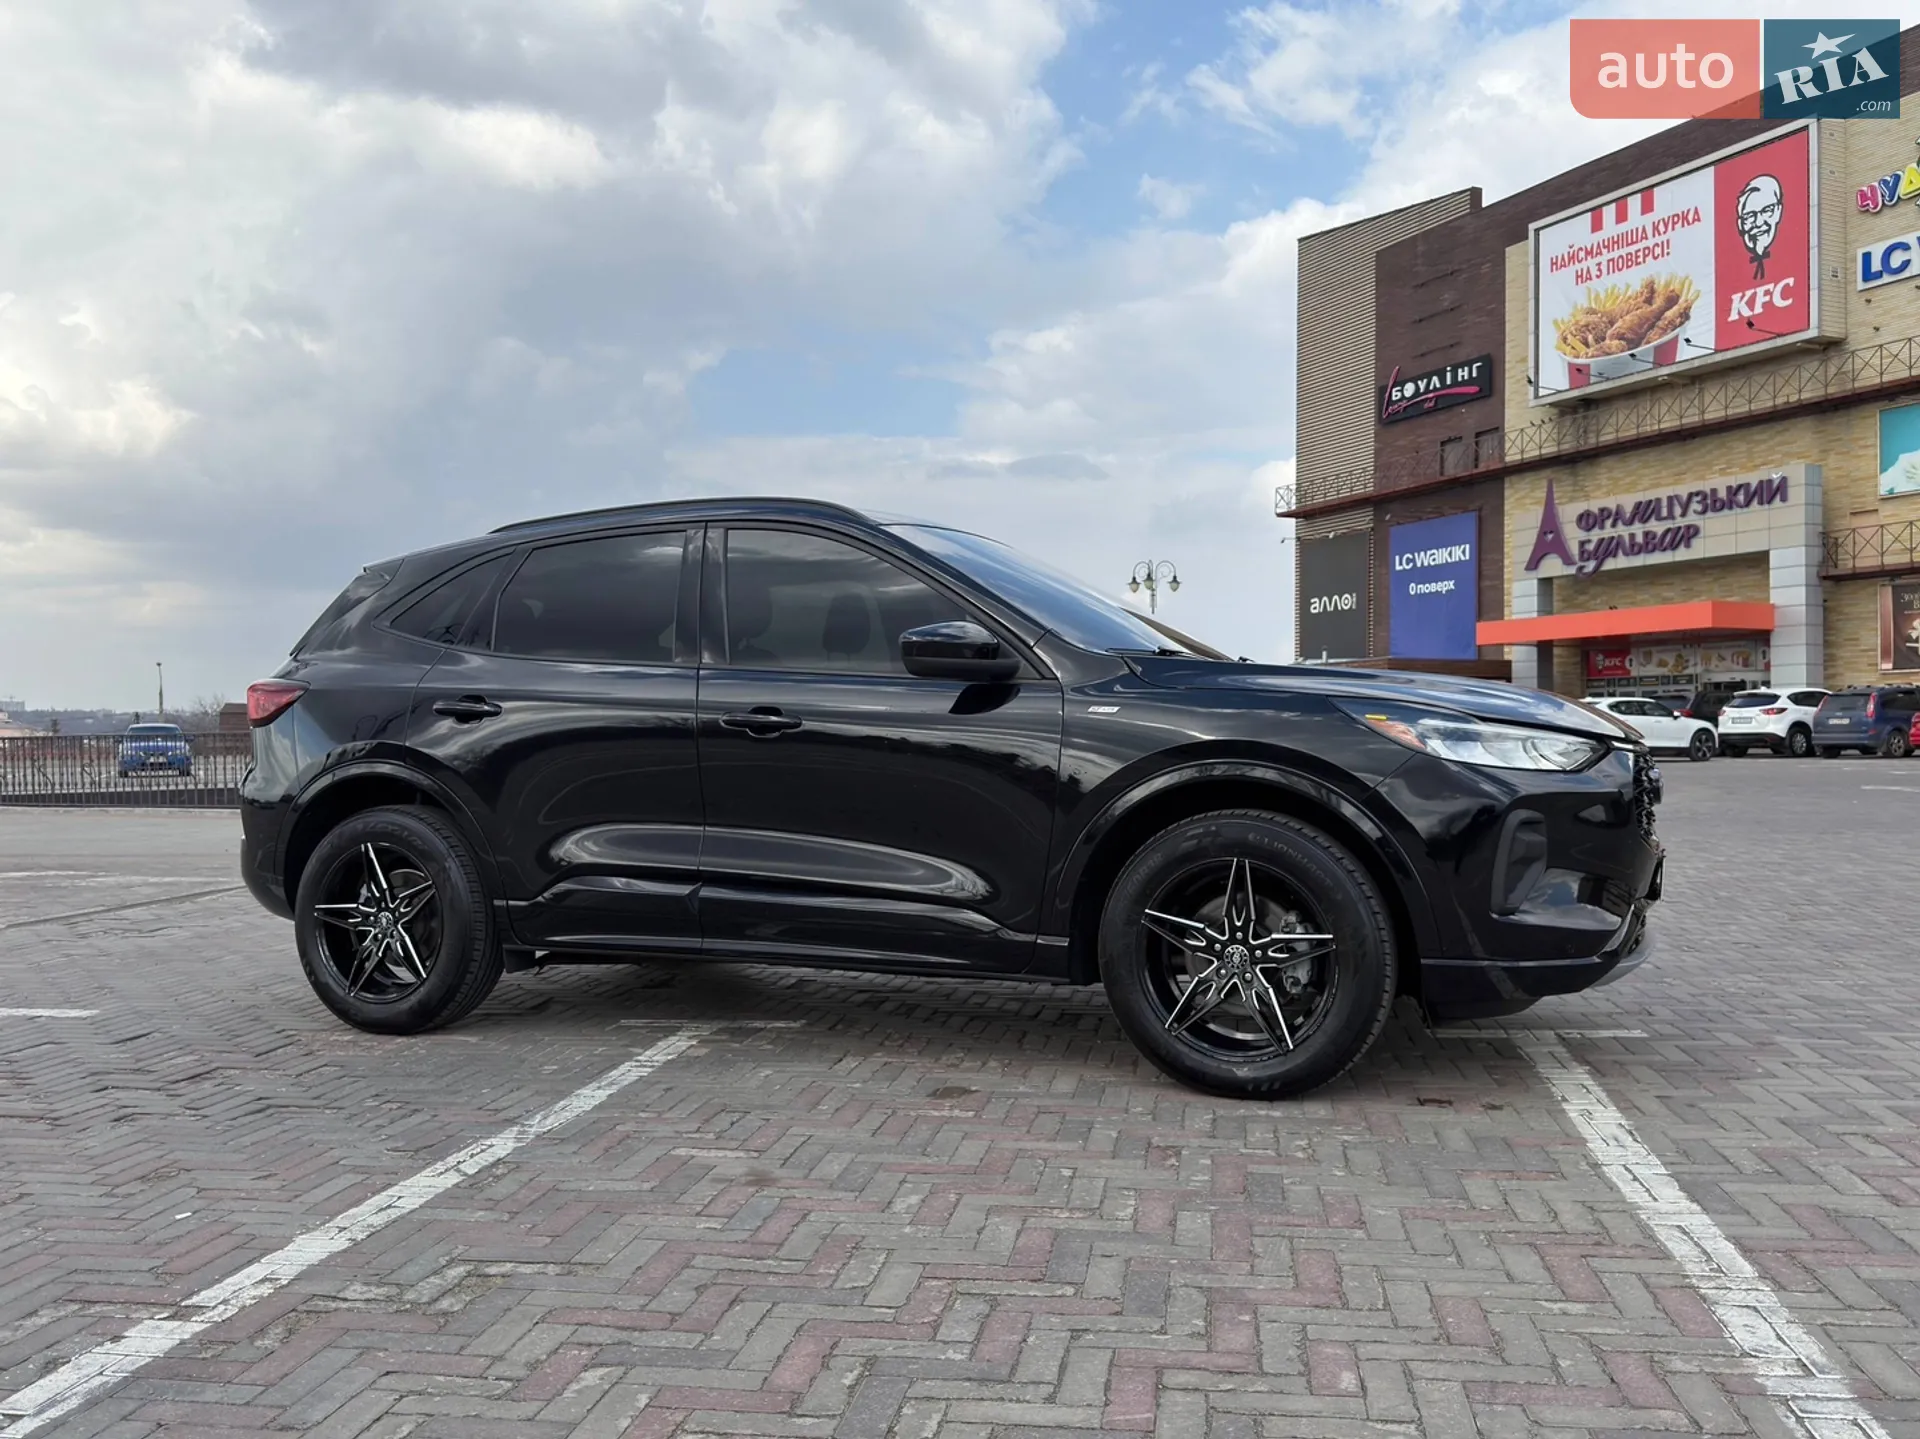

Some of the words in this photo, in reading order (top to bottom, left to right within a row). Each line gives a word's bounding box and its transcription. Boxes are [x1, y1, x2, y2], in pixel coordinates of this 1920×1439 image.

[1550, 225, 1649, 273] НАЙСМАЧНІША
[1652, 206, 1702, 238] КУРКА
[1575, 265, 1593, 286] НА
[1595, 262, 1603, 279] 3
[1606, 238, 1671, 276] ПОВЕРСІ!
[1862, 241, 1912, 282] LC
[1727, 277, 1795, 322] KFC
[1395, 553, 1413, 571] LC
[1417, 580, 1455, 594] поверх
